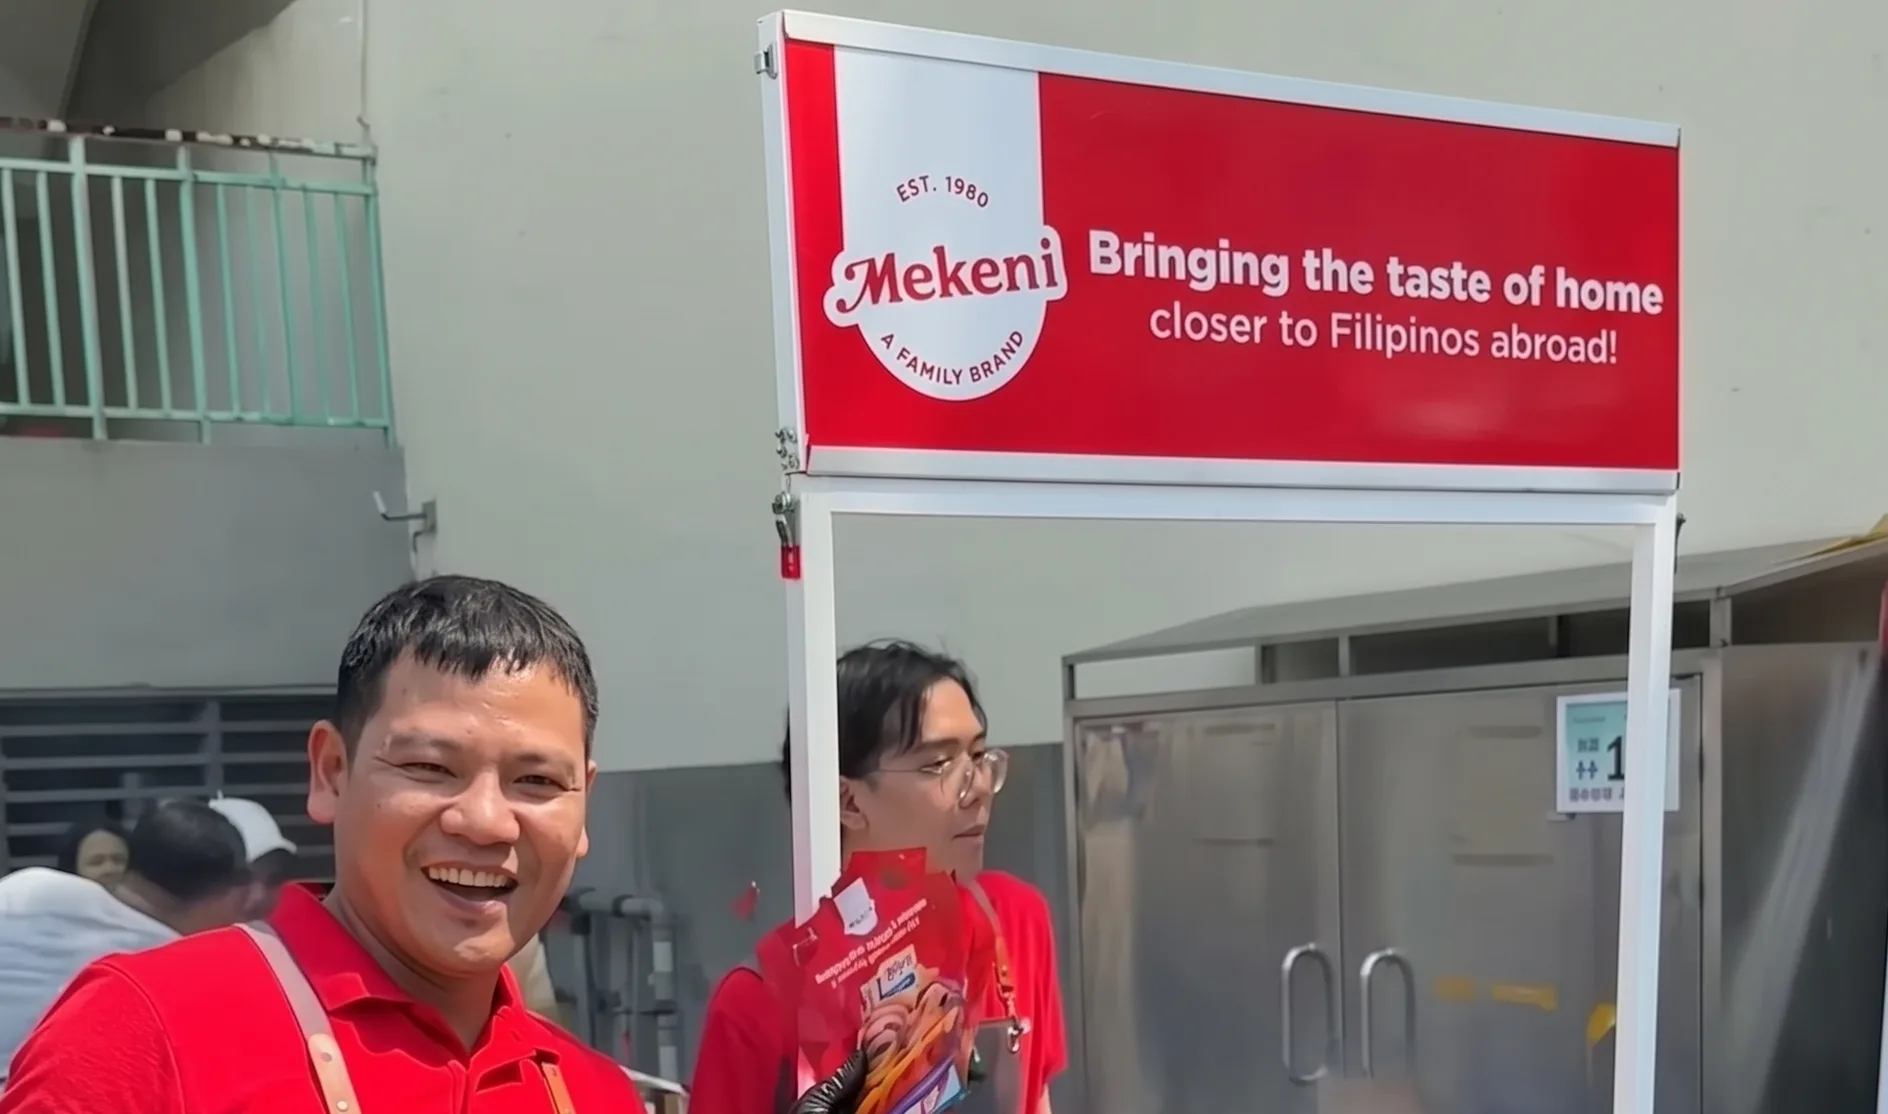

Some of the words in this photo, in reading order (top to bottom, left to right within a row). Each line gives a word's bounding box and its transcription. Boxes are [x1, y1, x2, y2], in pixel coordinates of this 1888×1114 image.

[896, 175, 938, 203] EST.
[944, 176, 990, 208] 1980
[835, 236, 1059, 314] Mekeni
[1088, 229, 1290, 297] Bringing
[1302, 247, 1376, 295] the
[1386, 256, 1492, 303] taste
[1503, 264, 1546, 307] of
[1556, 266, 1665, 315] home
[881, 333, 895, 350] A
[896, 346, 963, 386] FAMILY
[968, 330, 1024, 383] BRAND
[1149, 300, 1268, 344] closer
[1279, 310, 1319, 348] to
[1330, 312, 1481, 360] Filipinos
[1490, 323, 1618, 365] abroad!
